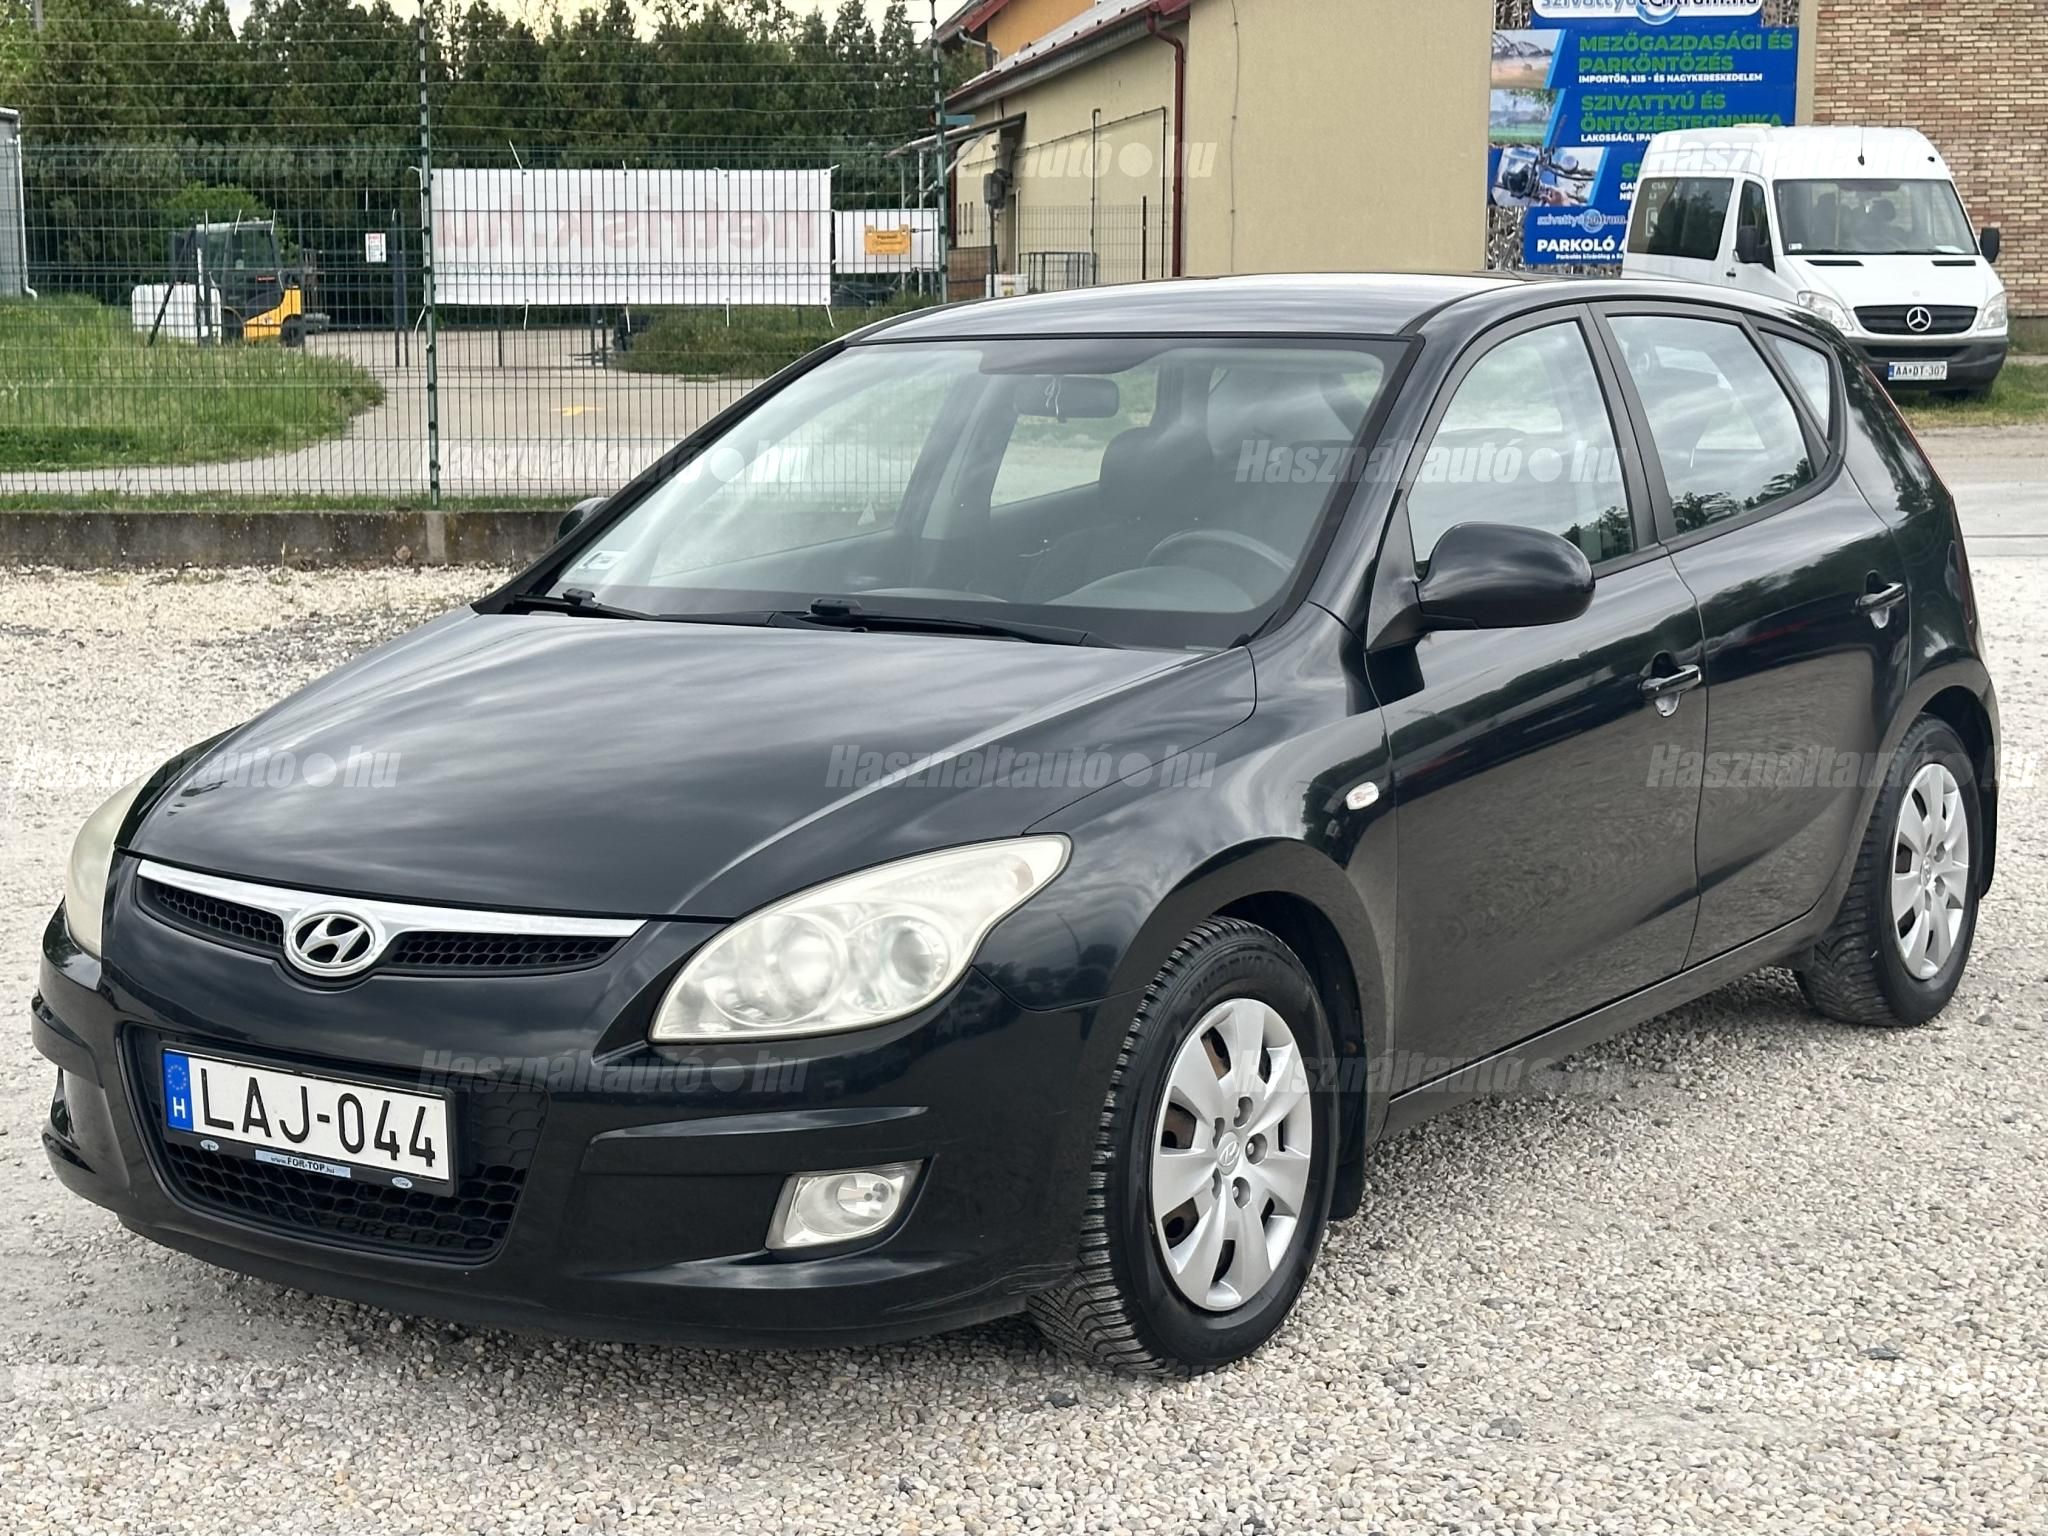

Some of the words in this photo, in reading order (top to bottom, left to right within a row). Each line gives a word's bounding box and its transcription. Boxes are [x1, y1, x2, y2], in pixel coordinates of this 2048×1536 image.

[1767, 30, 1793, 49] ÉS
[1579, 53, 1734, 73] PARKÖNTÖZÉS
[1631, 74, 1646, 83] KIS
[1653, 72, 1665, 83] ÉS
[1667, 73, 1762, 83] NAGYKERESKEDELEM
[1581, 91, 1695, 111] SZIVATTYÚ
[1701, 91, 1727, 110] ÉS
[1537, 235, 1615, 252] PARKOLÓ
[172, 1097, 186, 1119] H
[200, 1067, 437, 1168] LAJ-044
